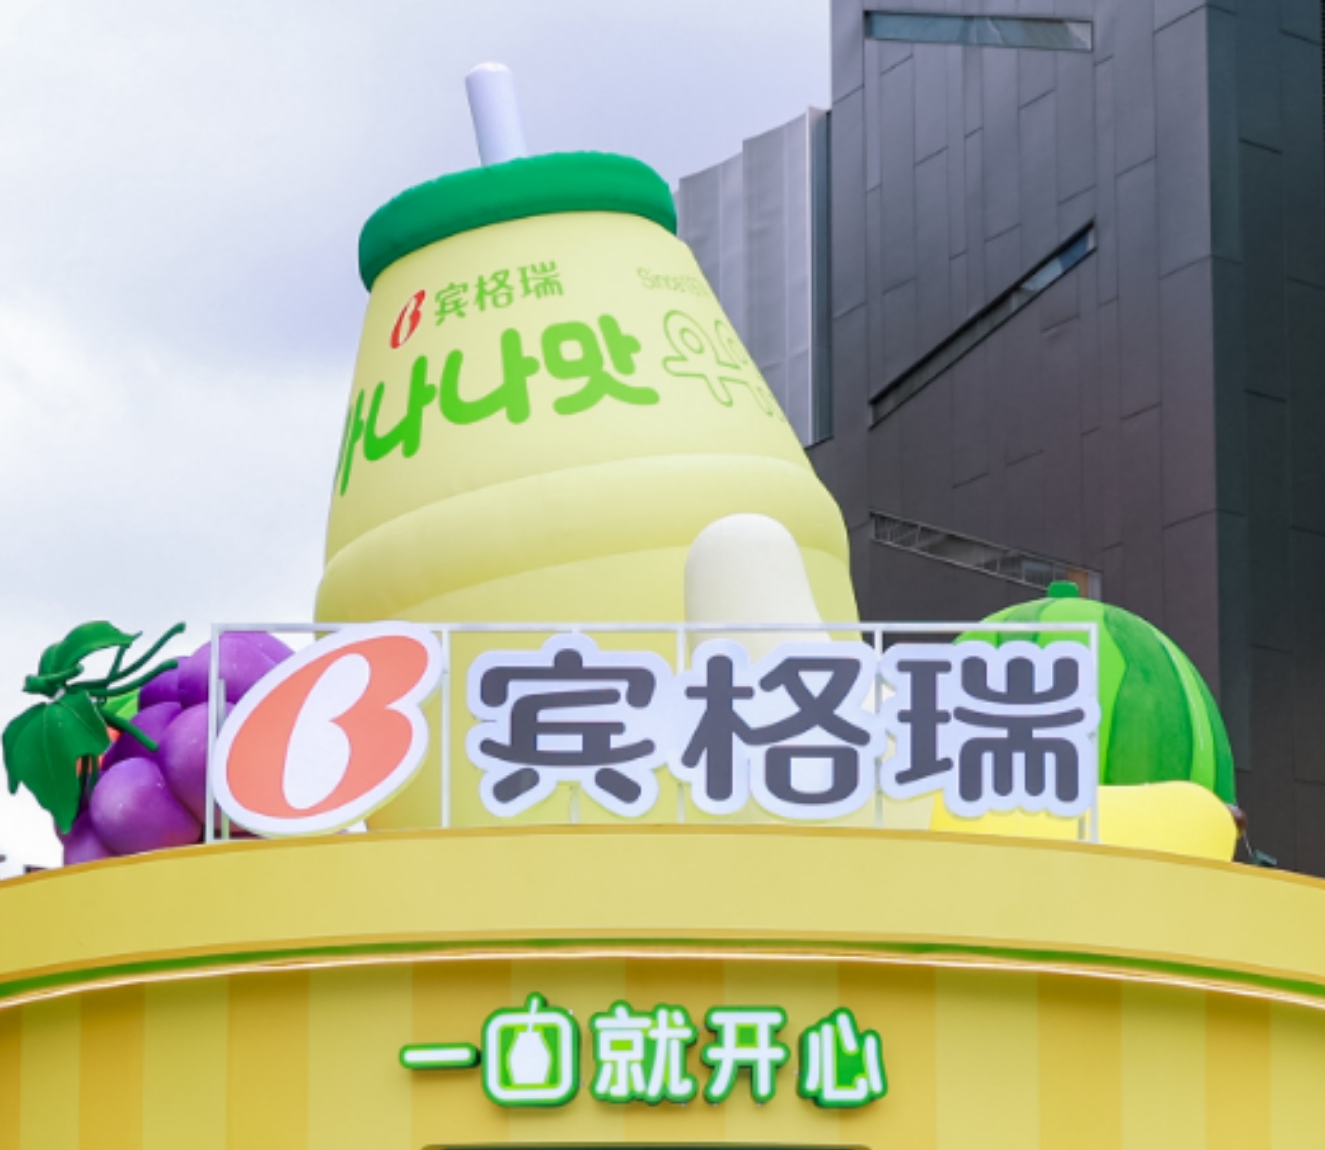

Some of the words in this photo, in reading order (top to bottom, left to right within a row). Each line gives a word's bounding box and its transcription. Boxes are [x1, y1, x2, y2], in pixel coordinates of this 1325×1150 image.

[433, 261, 565, 327] 宾格瑞
[478, 648, 1088, 808] 宾格瑞
